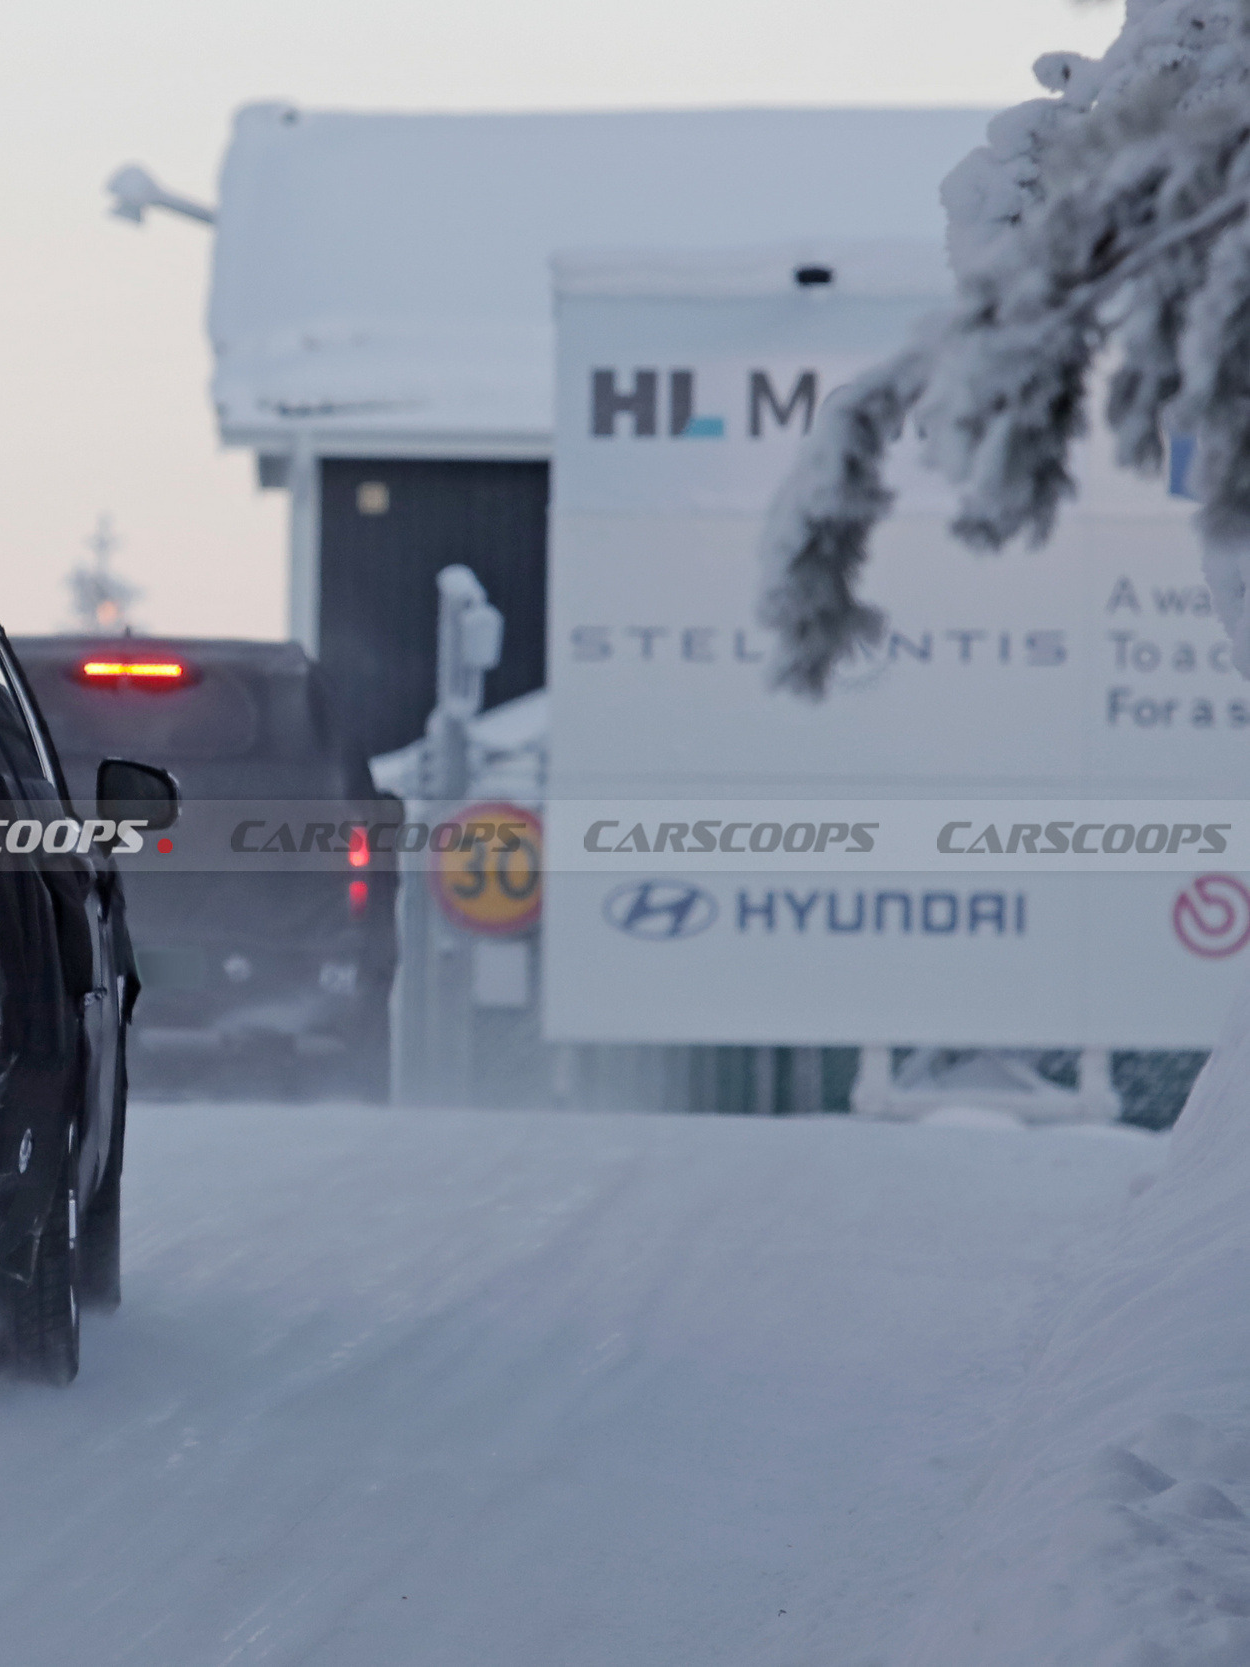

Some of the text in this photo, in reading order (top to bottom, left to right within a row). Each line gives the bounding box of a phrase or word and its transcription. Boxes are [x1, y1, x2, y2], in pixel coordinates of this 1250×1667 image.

[592, 369, 725, 438] HL
[1106, 575, 1212, 616] A wa
[571, 625, 1068, 665] STELNTIS
[1107, 629, 1161, 673] To
[1107, 686, 1180, 728] For
[452, 836, 539, 900] 30
[736, 889, 1027, 936] HYUNDAI
